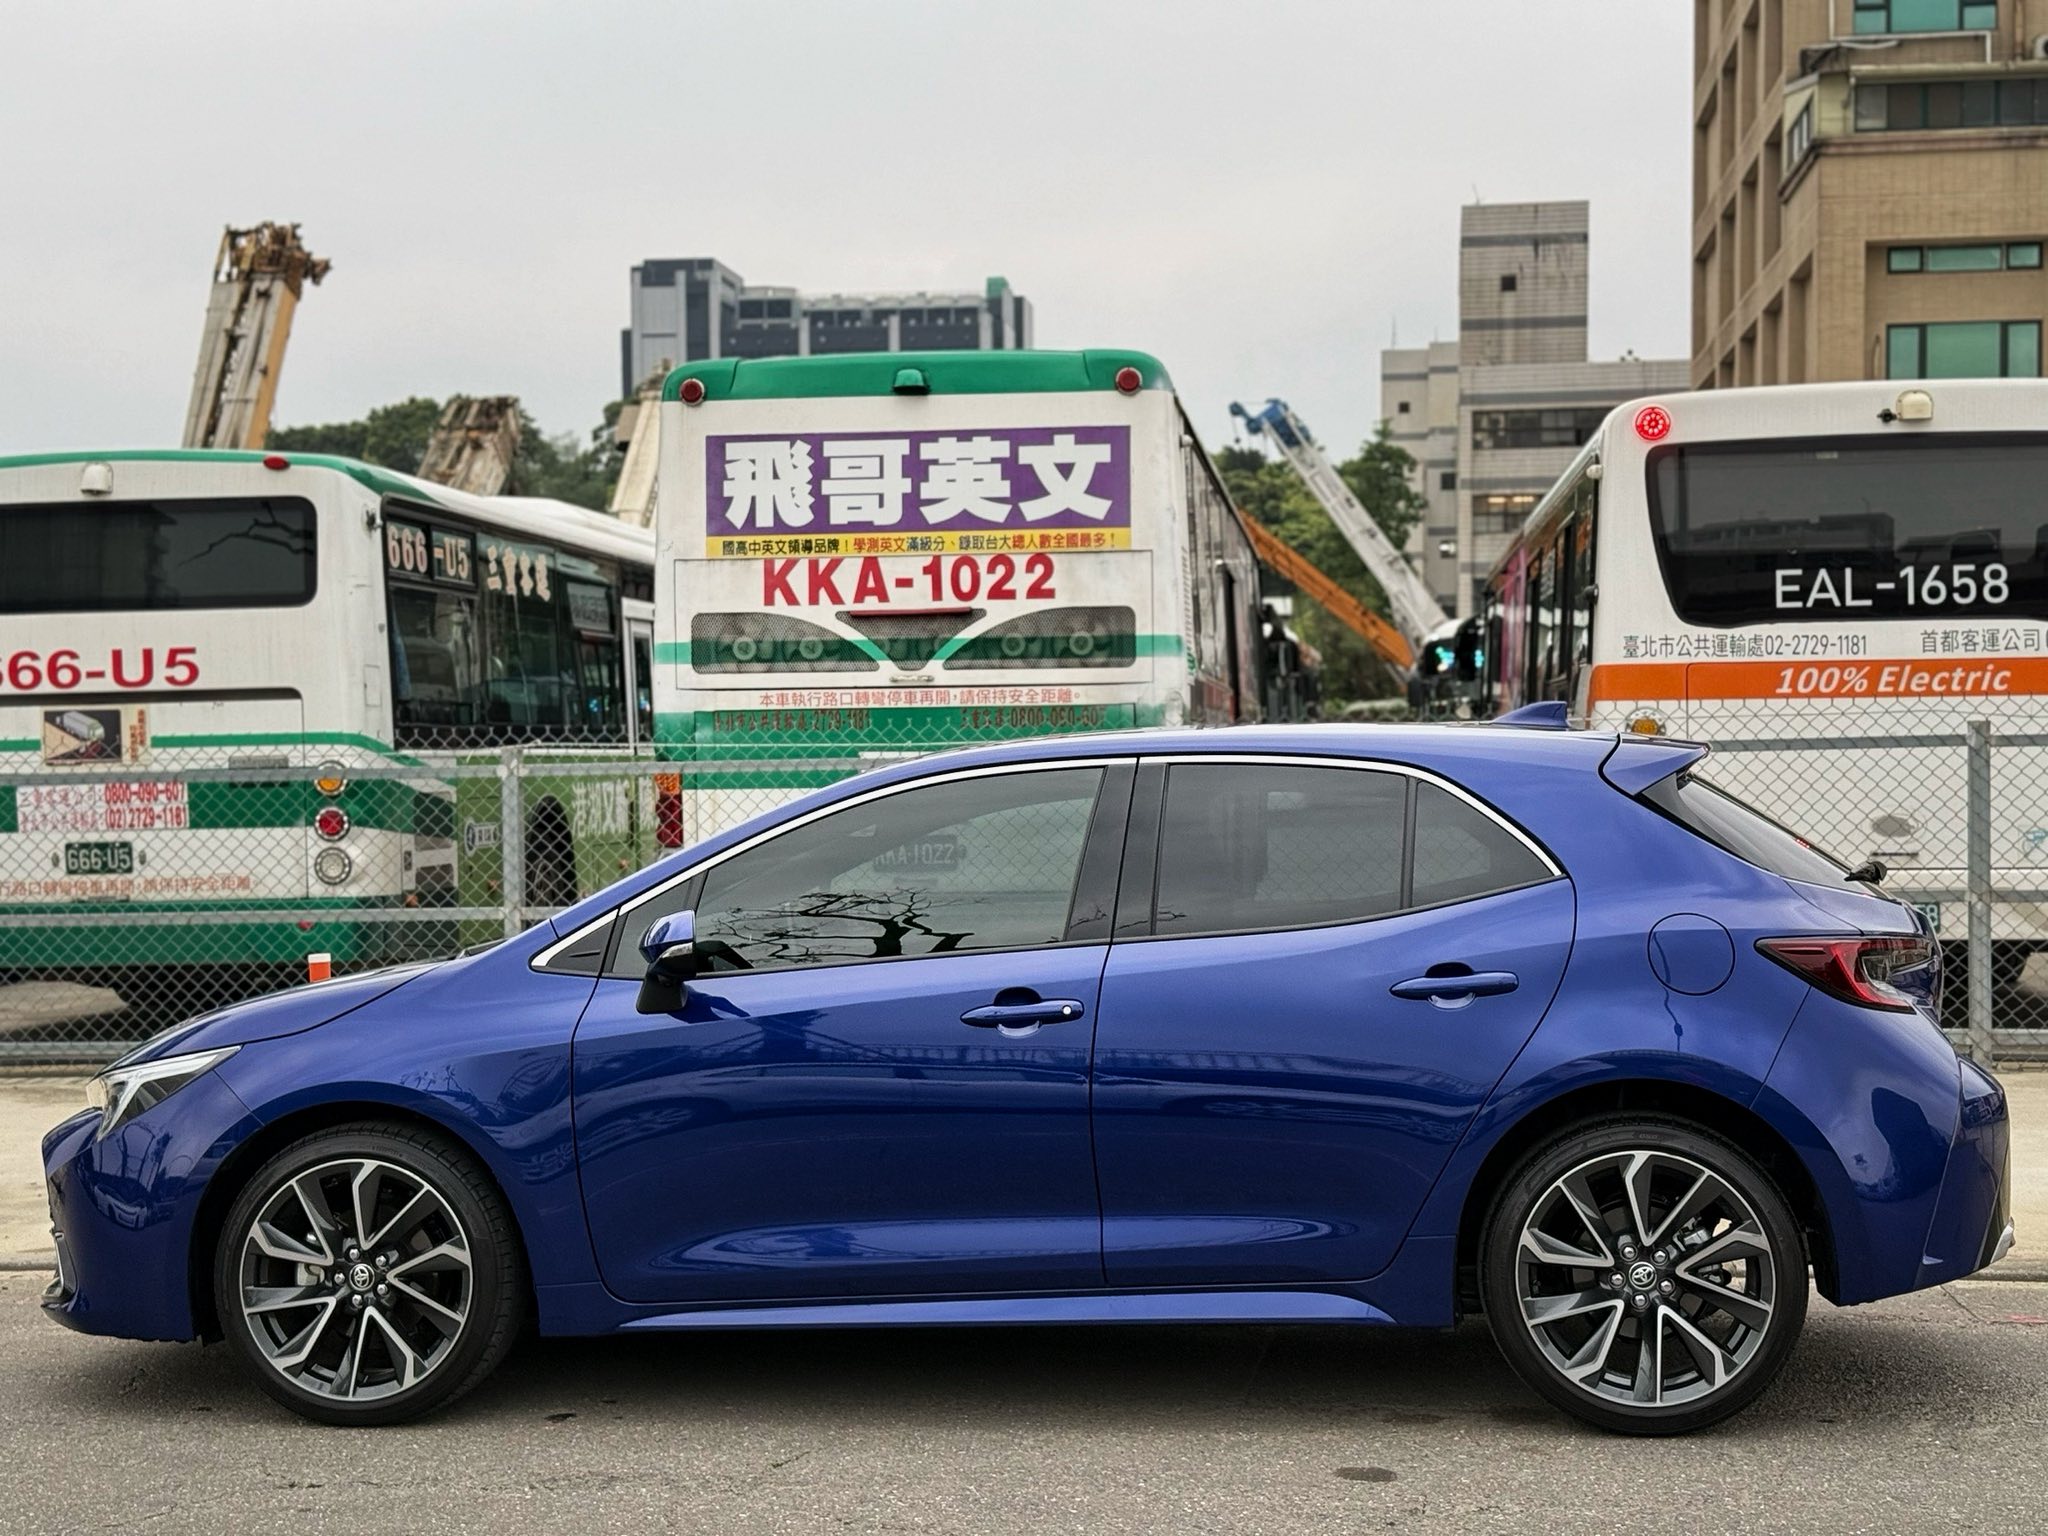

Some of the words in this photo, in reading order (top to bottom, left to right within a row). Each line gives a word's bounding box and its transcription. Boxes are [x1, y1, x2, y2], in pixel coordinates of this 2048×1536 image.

[722, 434, 1113, 531] 飛哥英文
[763, 552, 1057, 606] KKA-1022
[1775, 562, 2010, 609] EAL-1658
[0, 646, 200, 691] 66-U5
[1775, 665, 1871, 695] 100%
[1877, 663, 2012, 693] Electric
